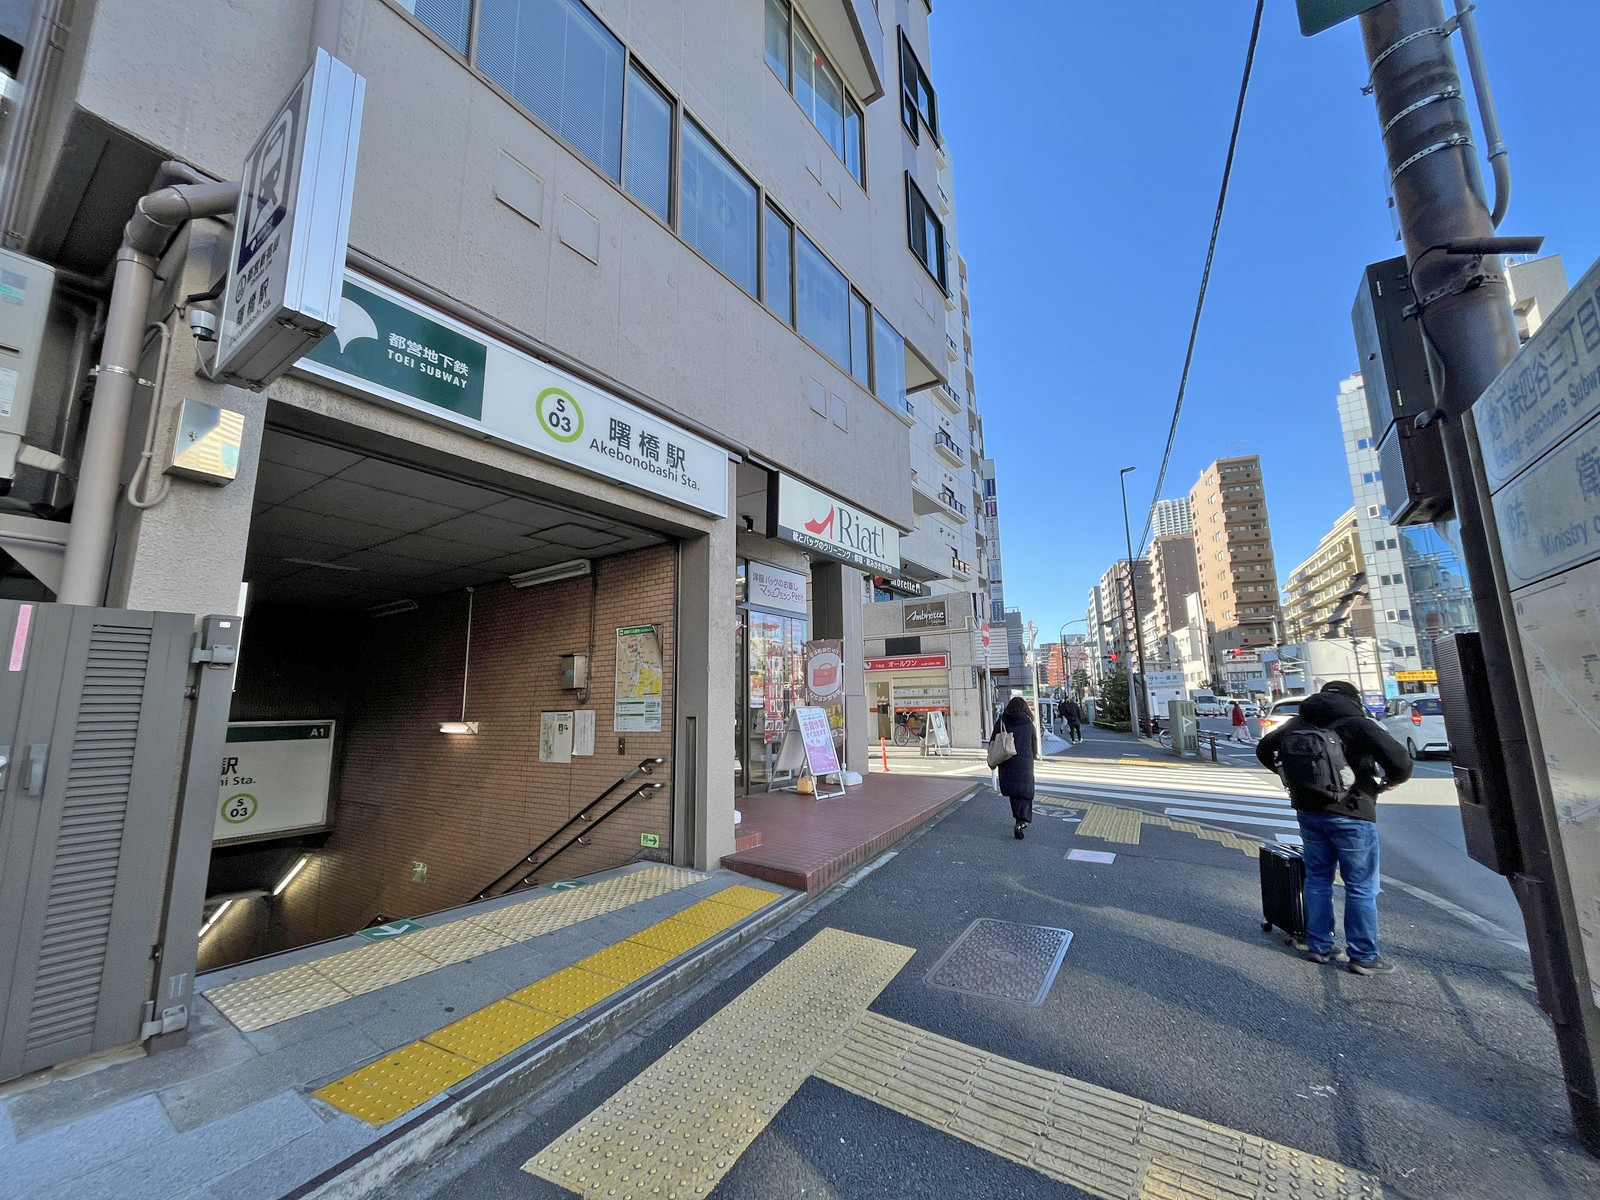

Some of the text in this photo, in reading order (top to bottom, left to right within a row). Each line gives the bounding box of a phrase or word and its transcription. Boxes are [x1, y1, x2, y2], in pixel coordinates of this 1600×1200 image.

[387, 348, 468, 389] TOEI SUBWAY
[388, 332, 469, 377] 都営地下鉄
[1487, 285, 1600, 441] 地下鉄四谷三丁目
[556, 398, 566, 413] S
[548, 411, 572, 433] 03
[609, 417, 686, 473] 曙橋駅
[589, 438, 701, 491] Akebonobashi Sta.
[837, 506, 886, 560] Riat!
[310, 728, 325, 737] A1
[232, 776, 257, 786] Sta.
[230, 807, 248, 818] 03
[236, 798, 244, 807] S
